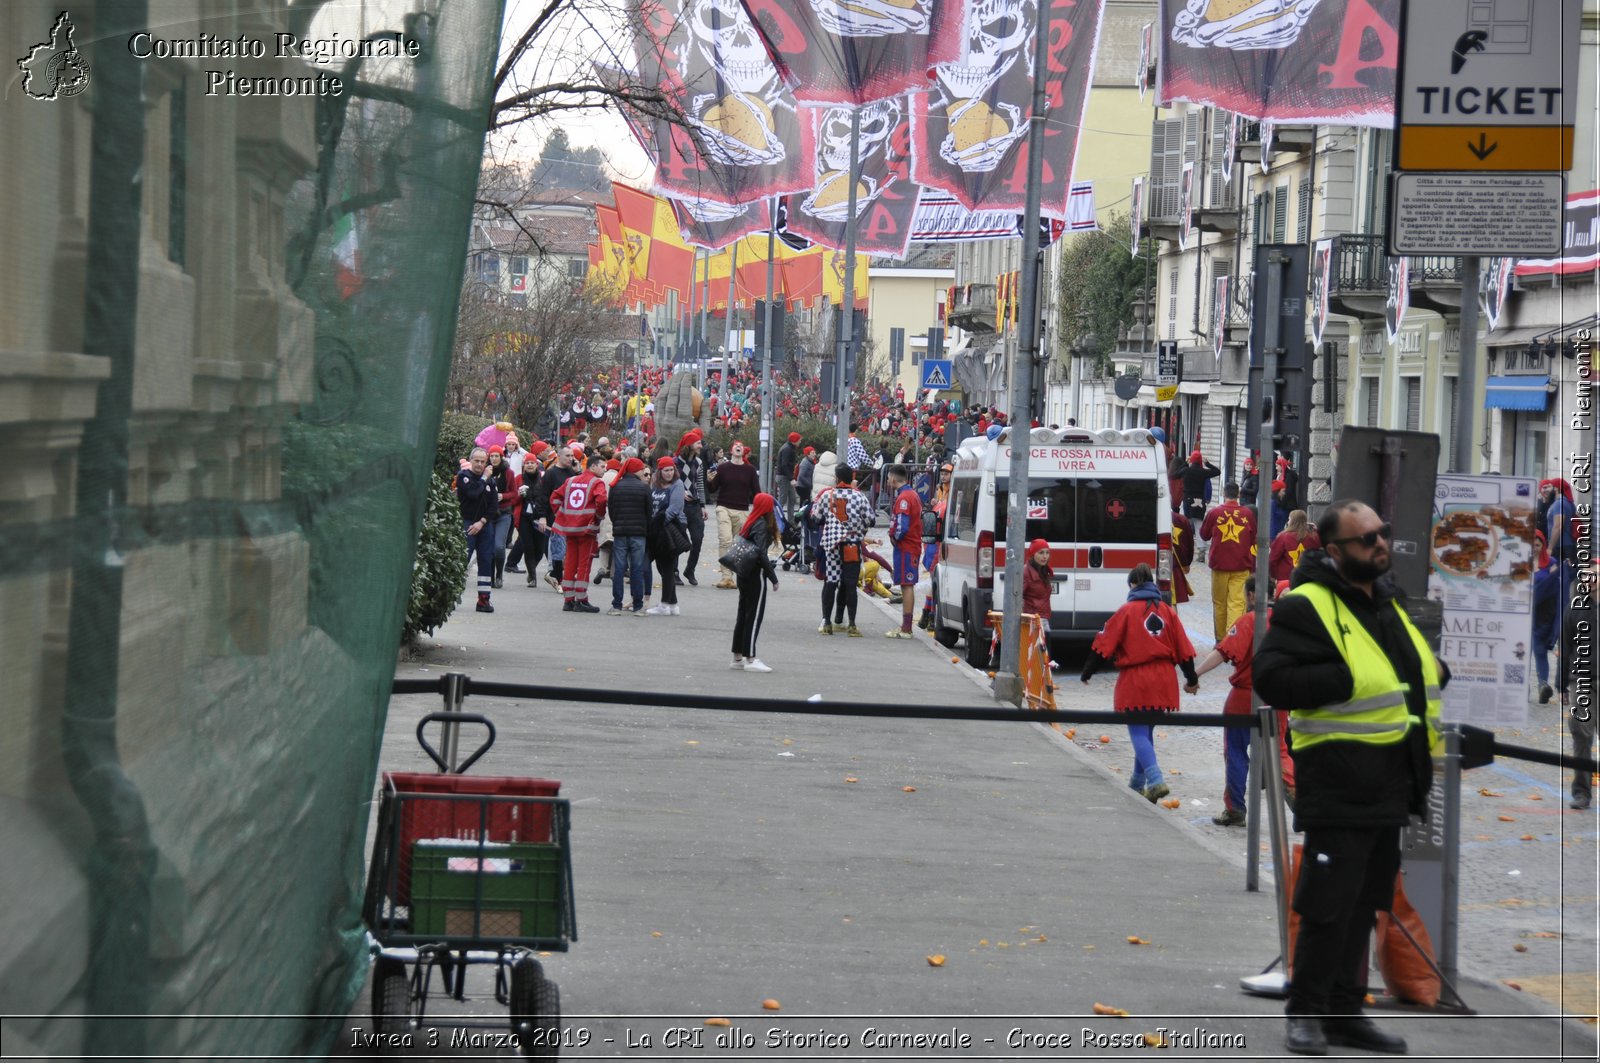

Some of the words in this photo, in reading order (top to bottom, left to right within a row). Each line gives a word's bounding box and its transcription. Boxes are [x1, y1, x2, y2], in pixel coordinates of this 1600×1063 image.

[1416, 86, 1561, 115] TICKET
[1504, 352, 1517, 370] BAR
[1006, 449, 1046, 458] COCE
[1051, 449, 1091, 459] ROSSA
[1095, 450, 1147, 459] ITALIANA
[1058, 461, 1096, 470] IVREA
